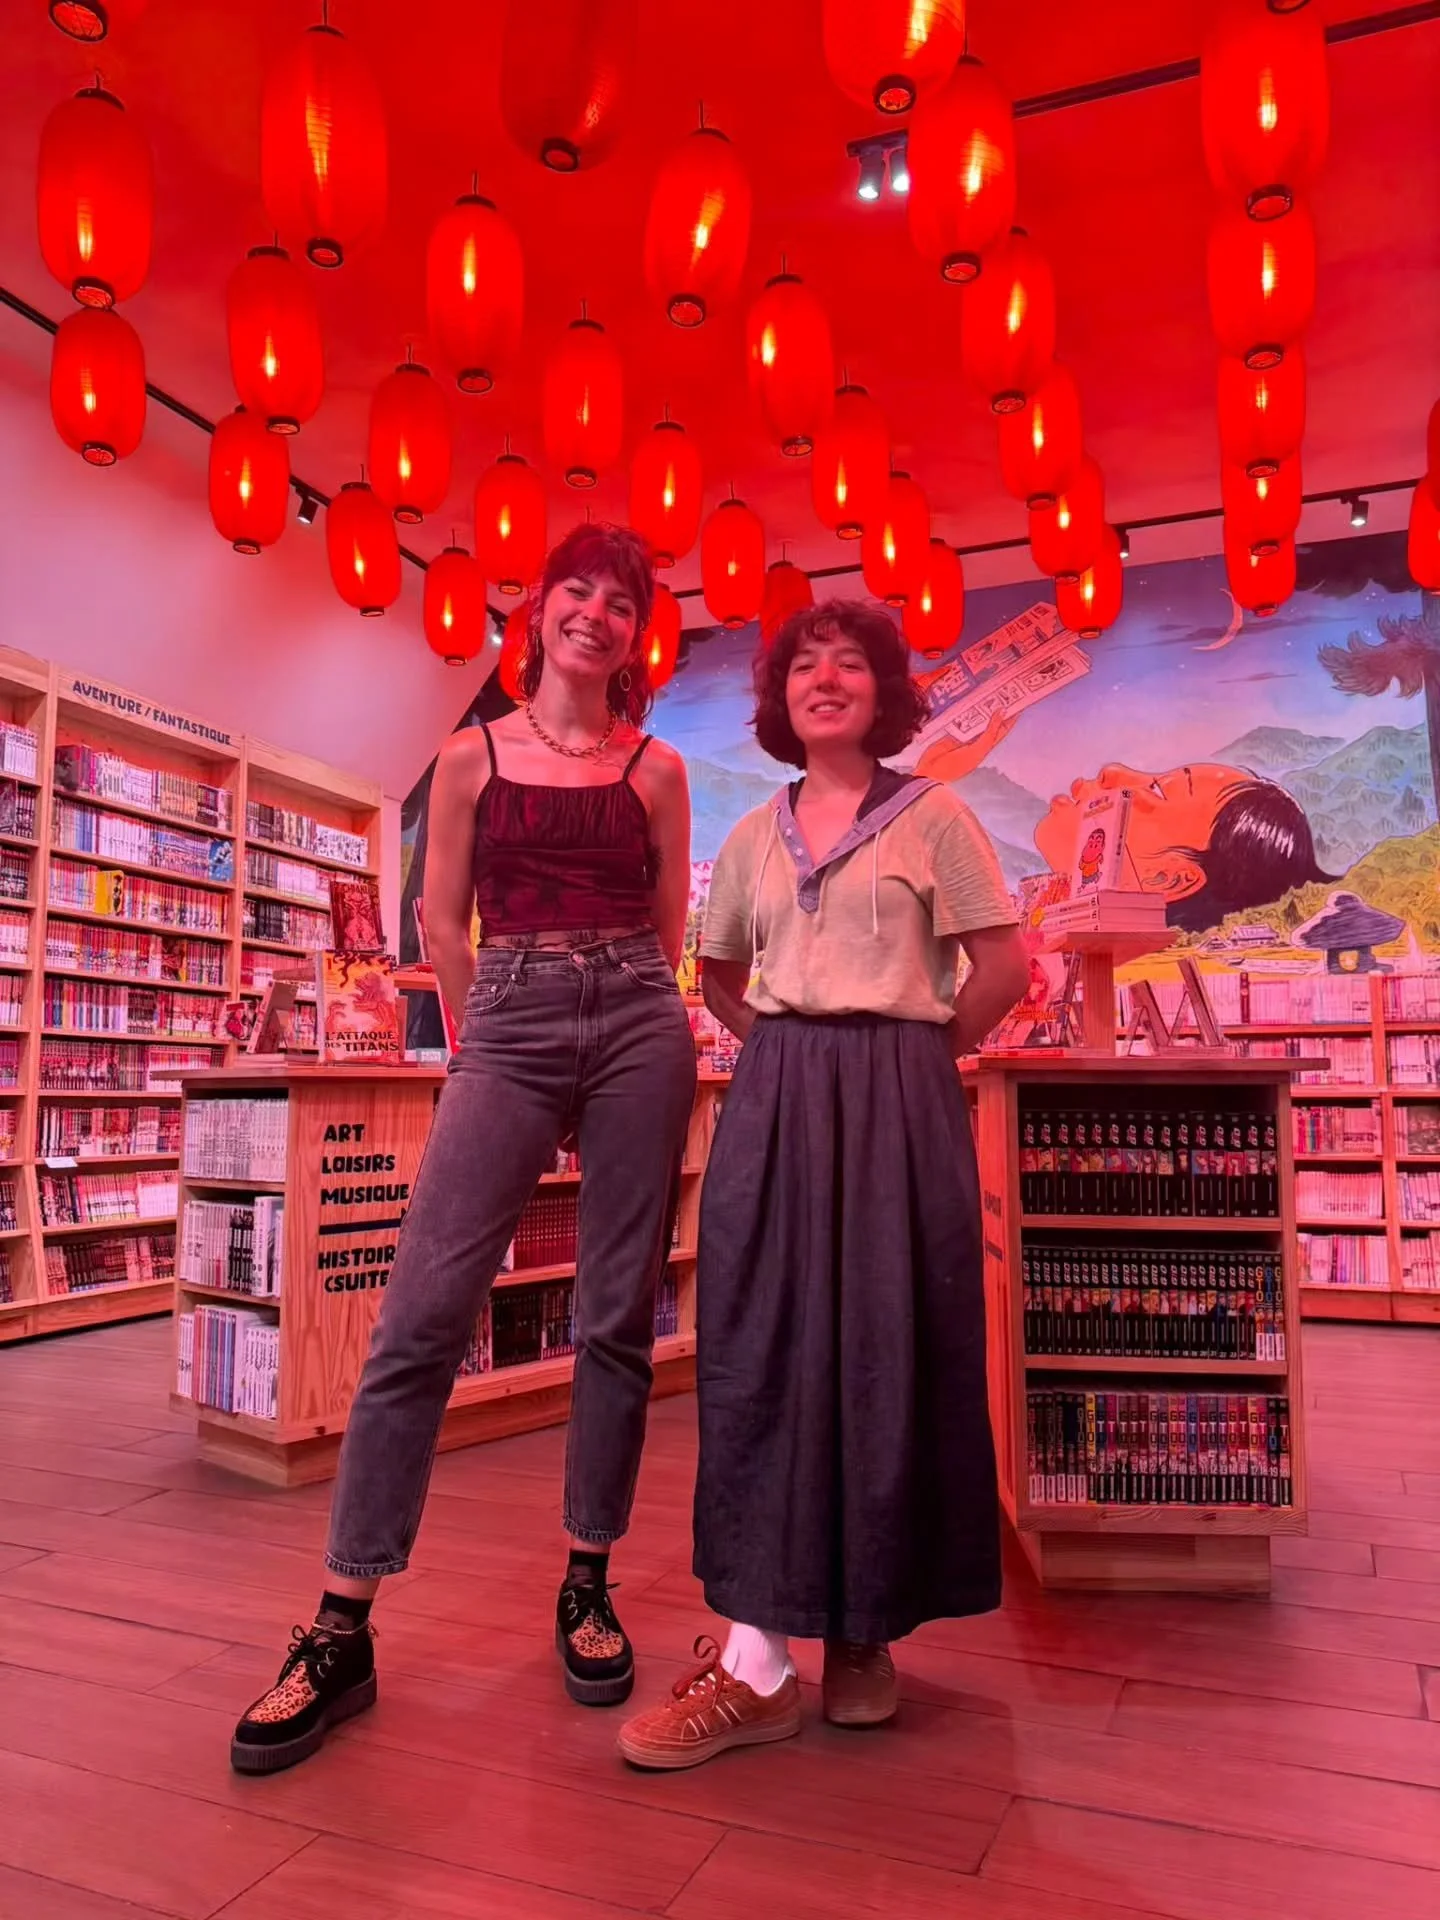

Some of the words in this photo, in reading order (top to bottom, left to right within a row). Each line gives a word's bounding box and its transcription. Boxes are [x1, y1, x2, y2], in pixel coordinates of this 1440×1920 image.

[73, 680, 141, 715] AVENTURE
[153, 709, 231, 745] FANTASTIQUE
[325, 1031, 393, 1041] L'ATTAQUE
[343, 1042, 399, 1052] TITANS
[323, 1123, 366, 1143] ART
[321, 1153, 396, 1174] LOISIRS
[320, 1183, 410, 1205] MUSIQUE
[317, 1244, 396, 1270] HISTOIR
[324, 1269, 390, 1293] (SUITE
[1256, 1266, 1264, 1302] GTO
